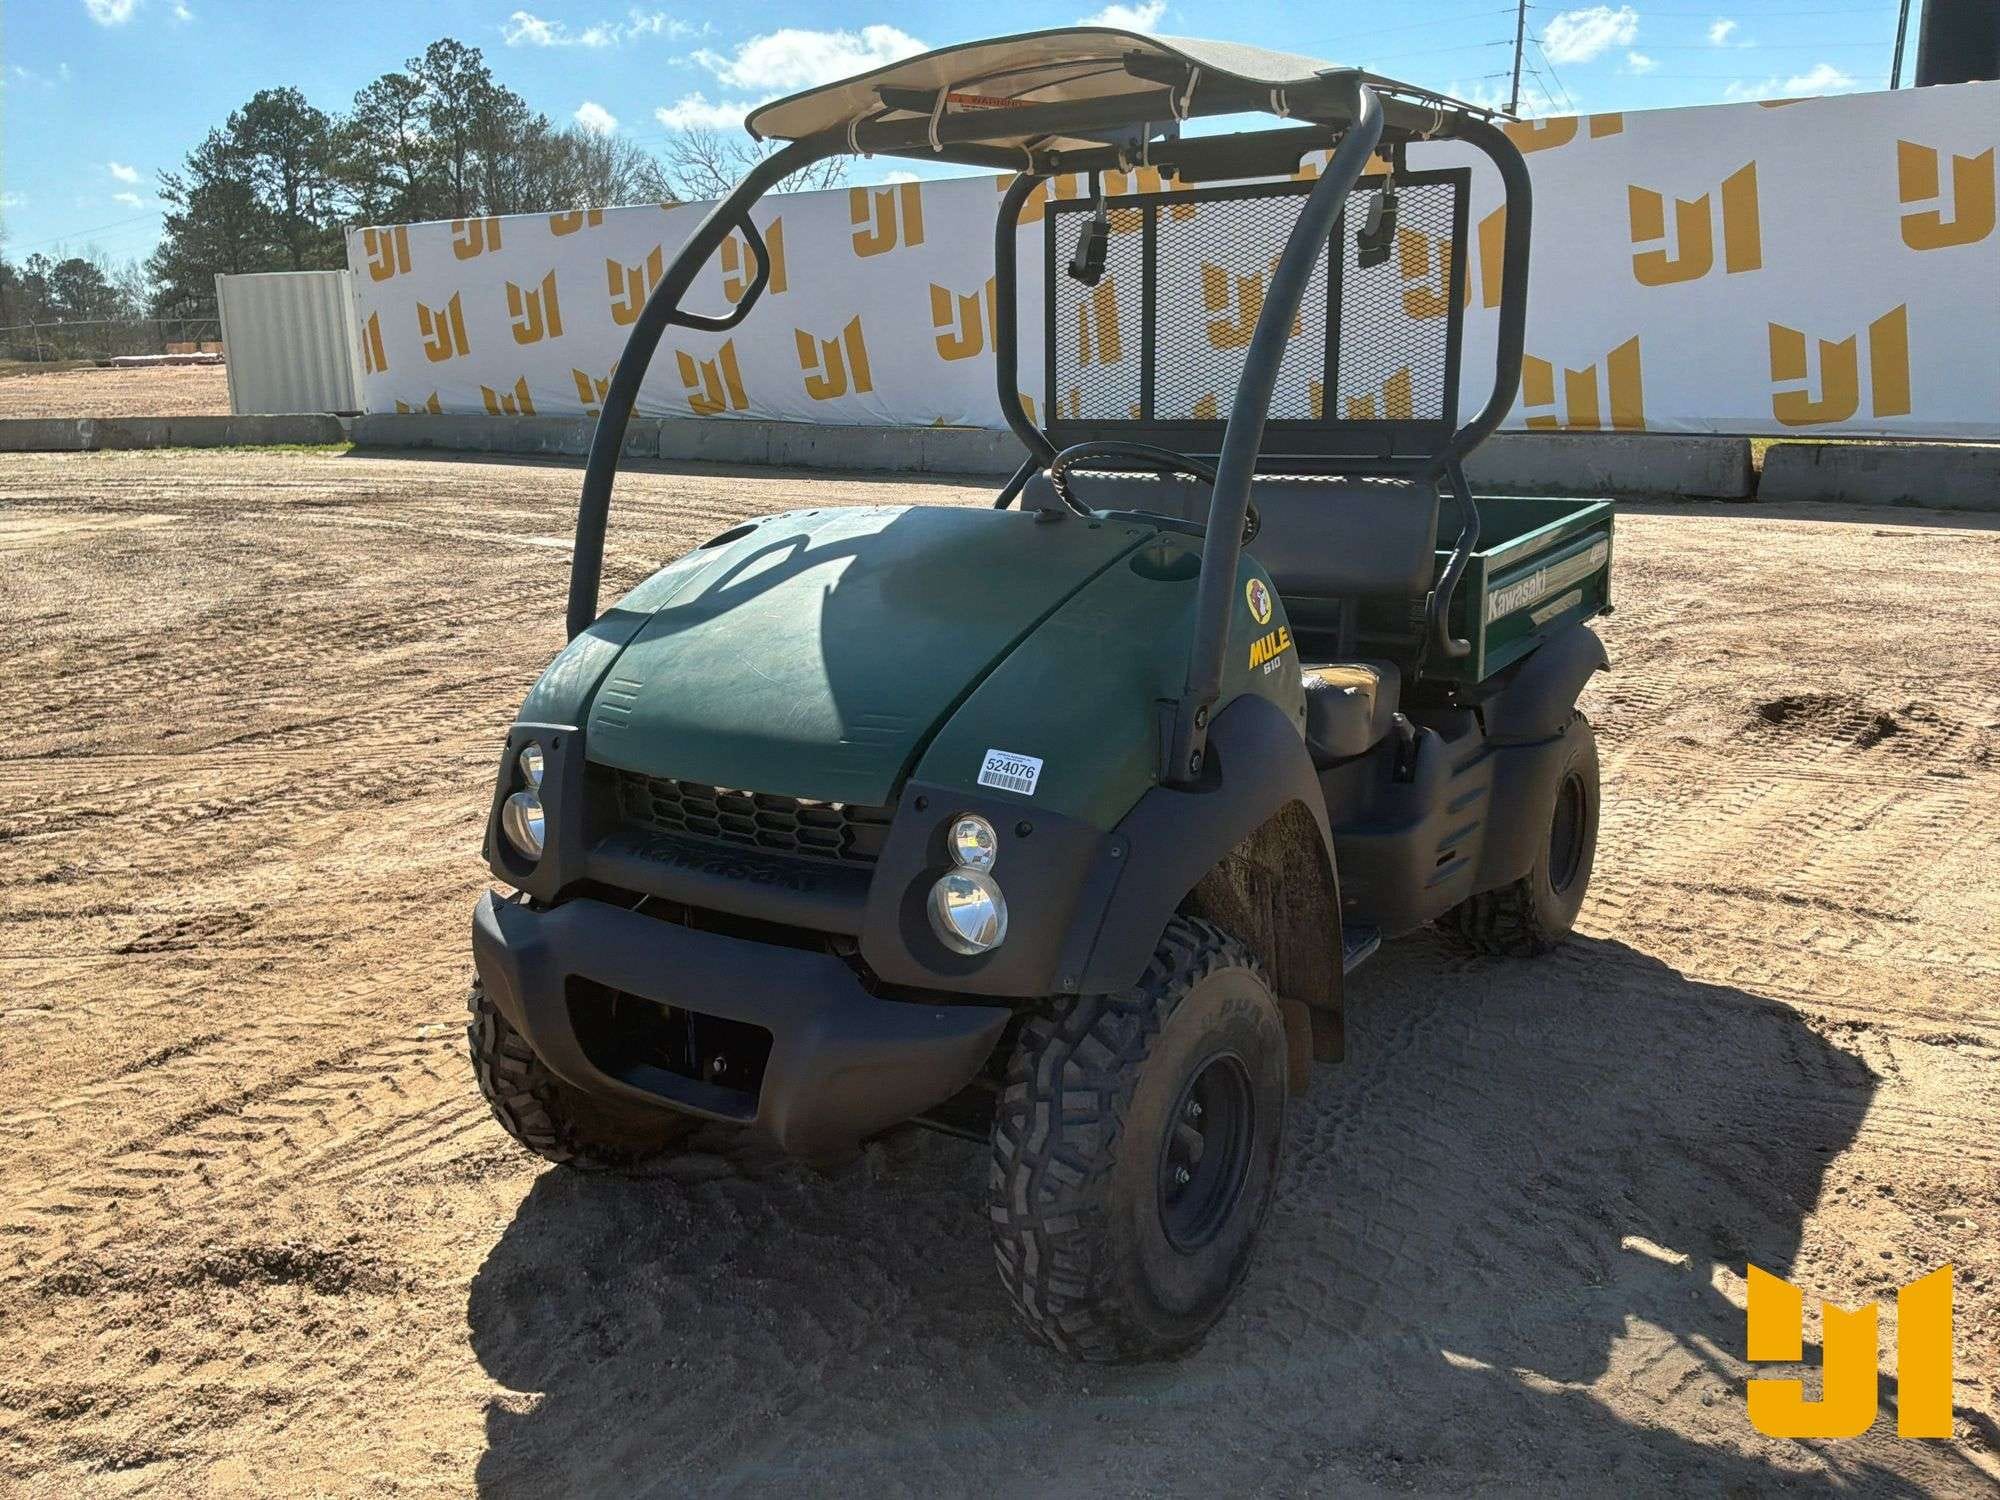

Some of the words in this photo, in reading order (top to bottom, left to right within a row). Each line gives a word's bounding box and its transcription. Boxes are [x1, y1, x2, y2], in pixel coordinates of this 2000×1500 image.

[1487, 566, 1546, 622] Kawasaki
[1248, 626, 1291, 671] MULE
[1263, 656, 1281, 675] 610
[986, 758, 1036, 779] 524076
